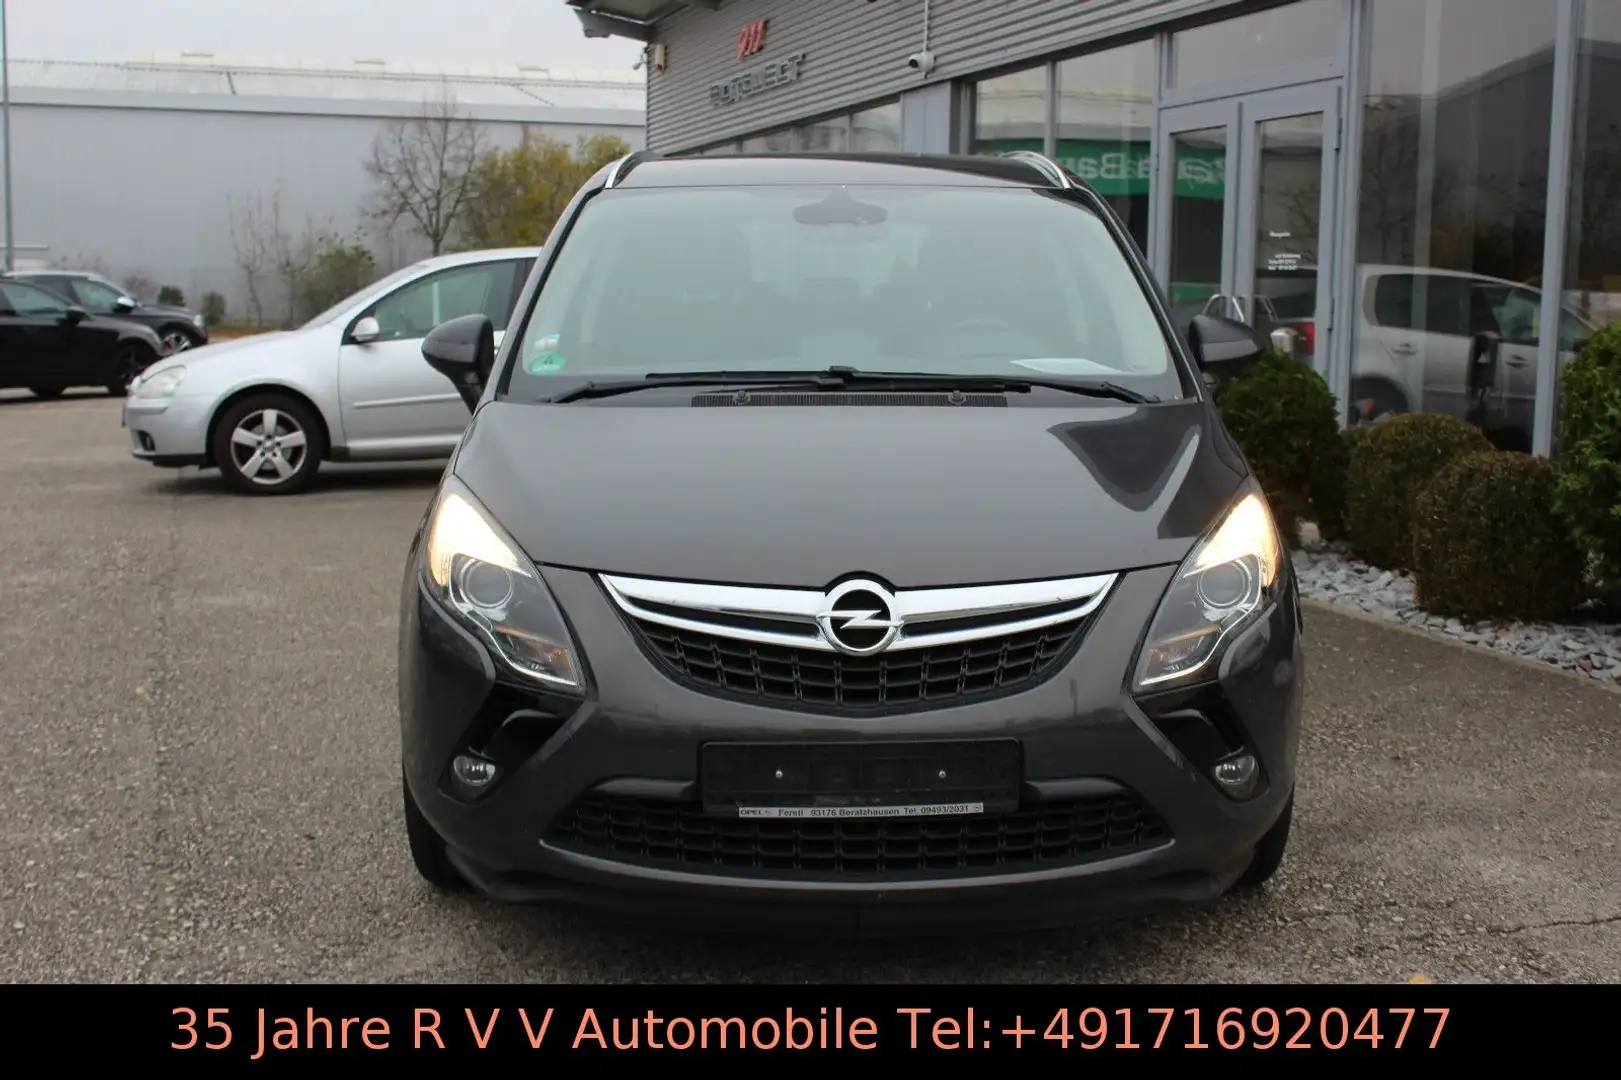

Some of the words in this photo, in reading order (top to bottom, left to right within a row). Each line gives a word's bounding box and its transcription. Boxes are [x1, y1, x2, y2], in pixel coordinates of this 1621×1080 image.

[810, 808, 837, 817] 93176
[839, 808, 900, 817] Beratzhausen
[920, 805, 969, 815] 09493/2031
